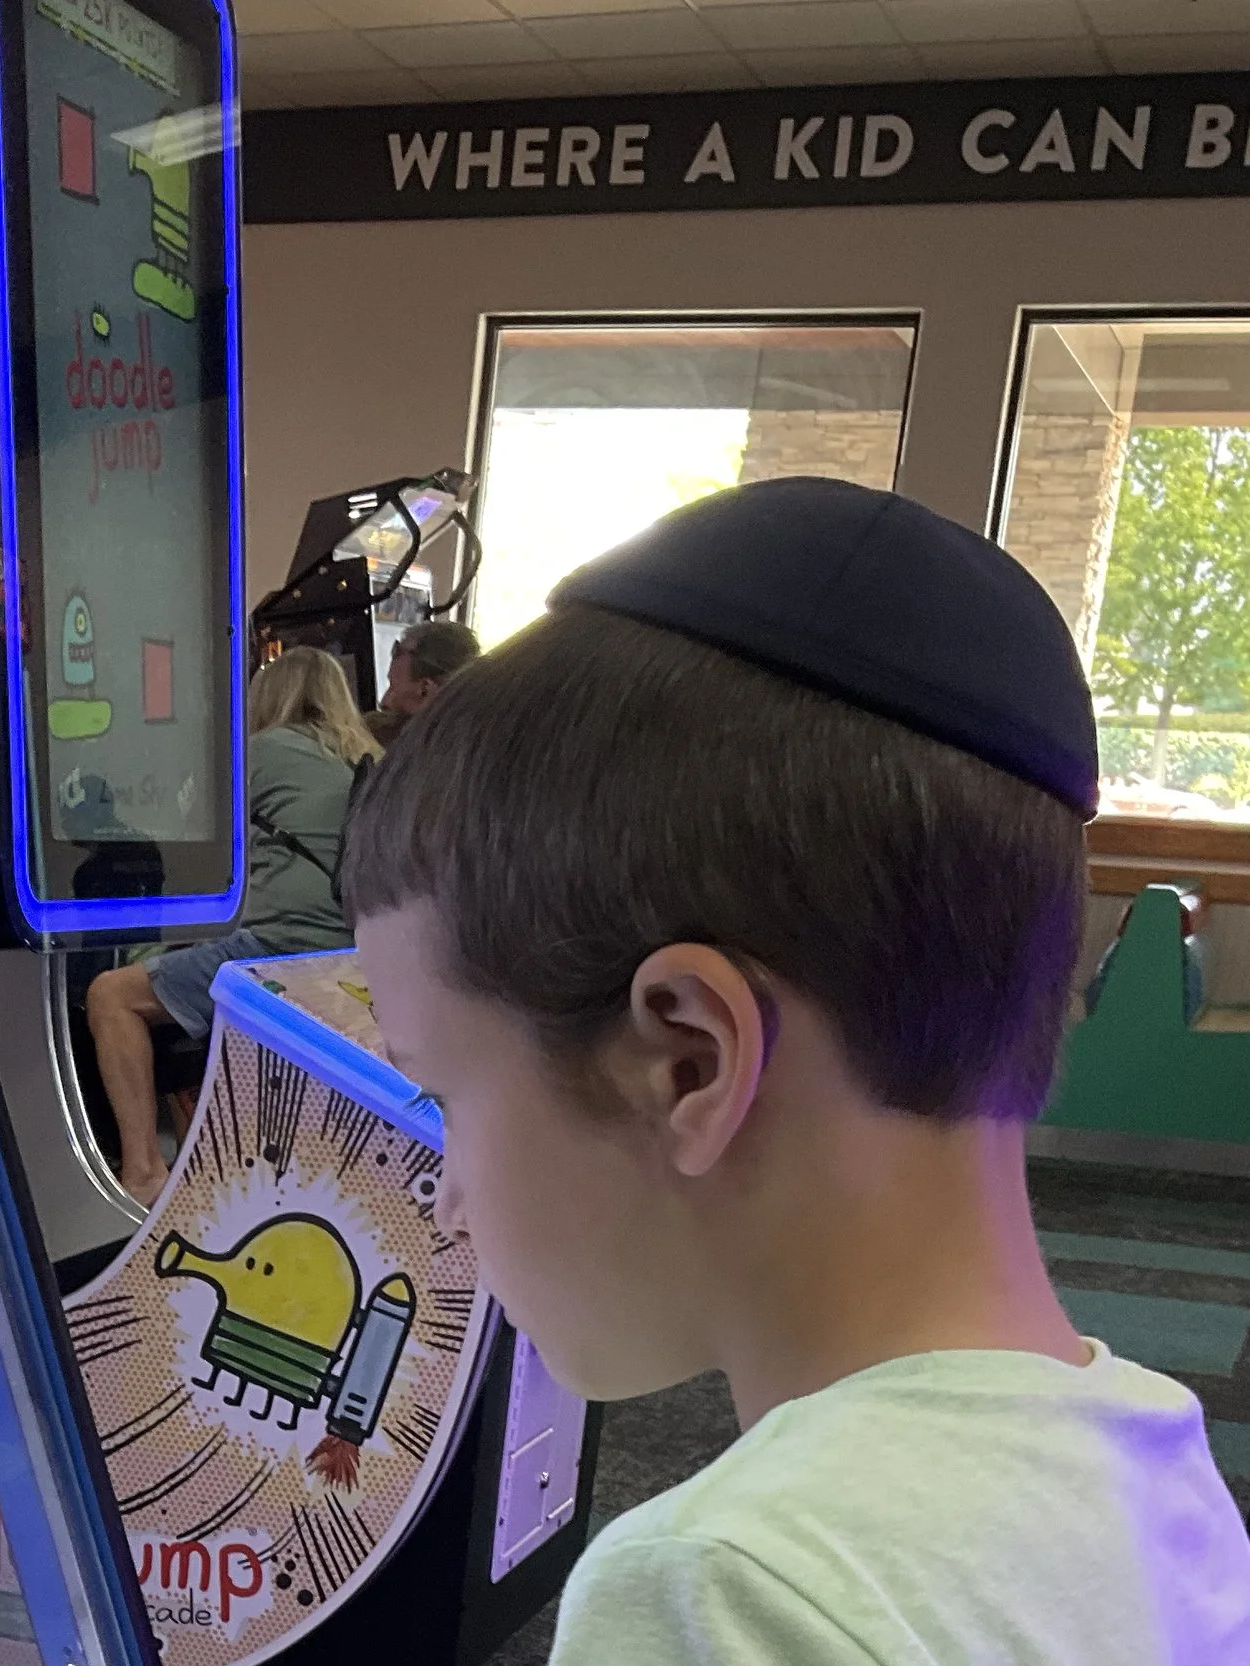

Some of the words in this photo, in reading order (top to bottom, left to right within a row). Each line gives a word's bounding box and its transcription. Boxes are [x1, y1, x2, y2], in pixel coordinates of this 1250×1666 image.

[388, 124, 649, 191] WHERE
[683, 121, 736, 184] A
[774, 114, 915, 180] KID
[961, 105, 1151, 174] CAN
[66, 311, 177, 410] doodle
